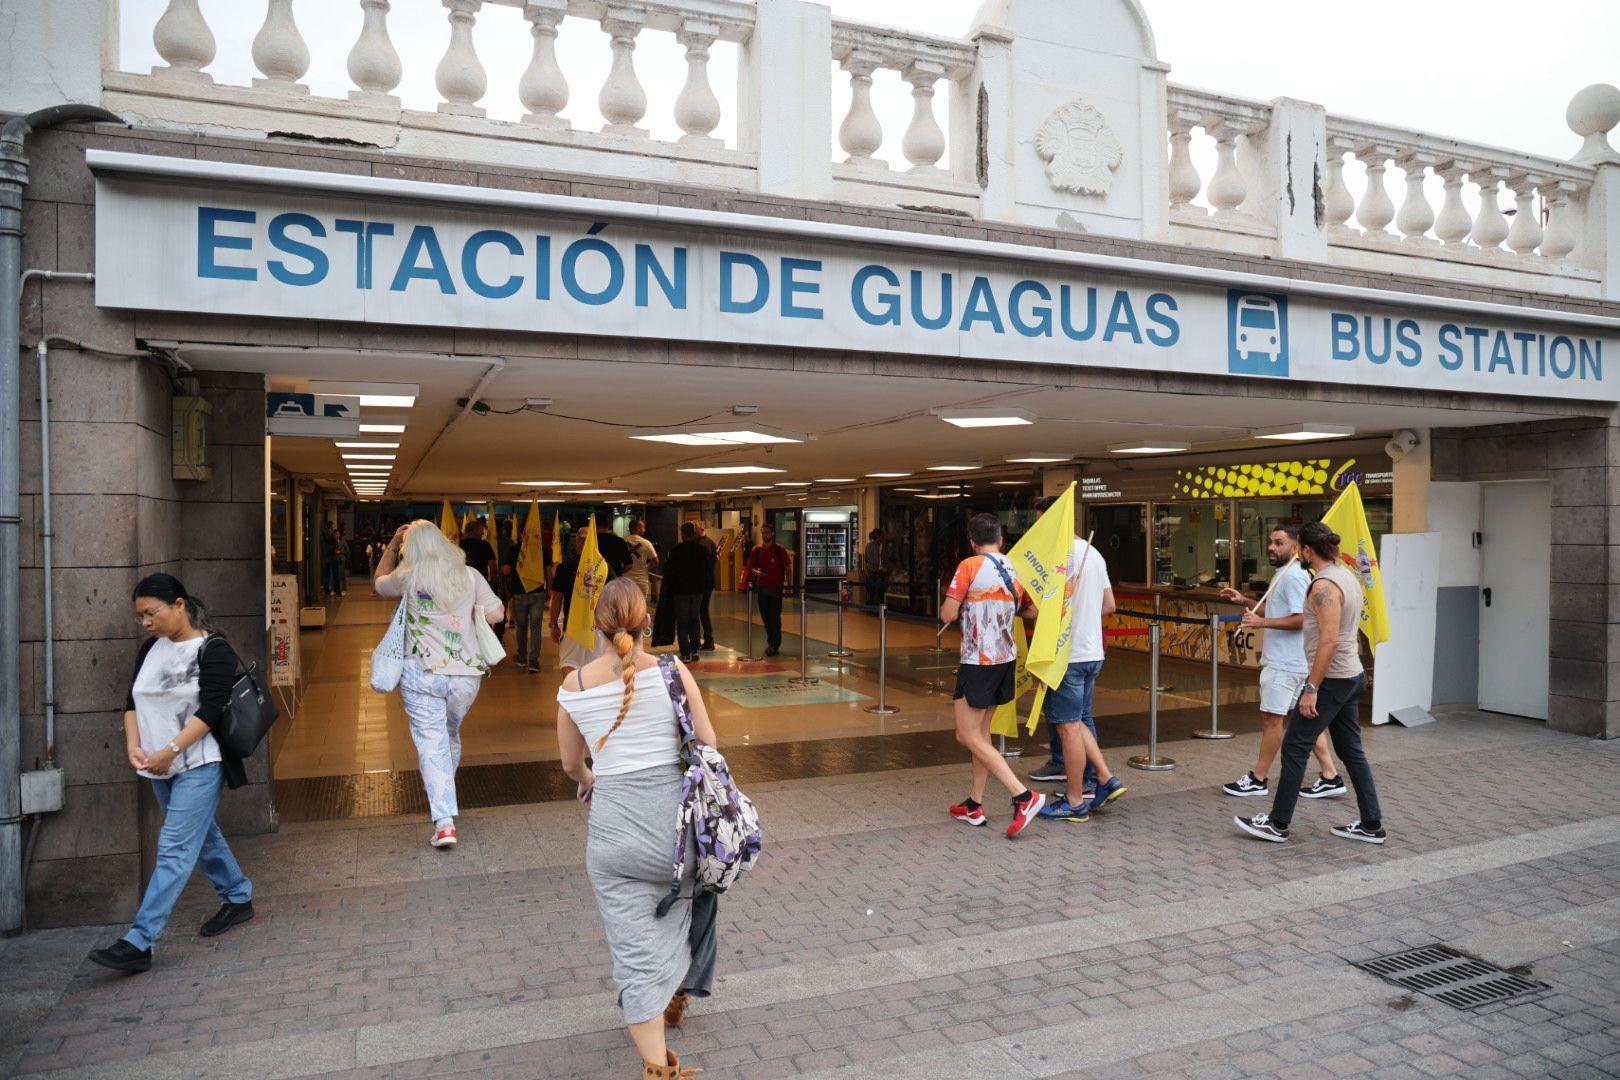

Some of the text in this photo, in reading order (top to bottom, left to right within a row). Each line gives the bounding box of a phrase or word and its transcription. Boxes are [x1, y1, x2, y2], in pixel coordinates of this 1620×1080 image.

[197, 207, 1181, 348] ESTACIÓN DE GUAGUAS
[1332, 314, 1604, 382] BUS STATION
[1024, 550, 1049, 584] SINDIC
